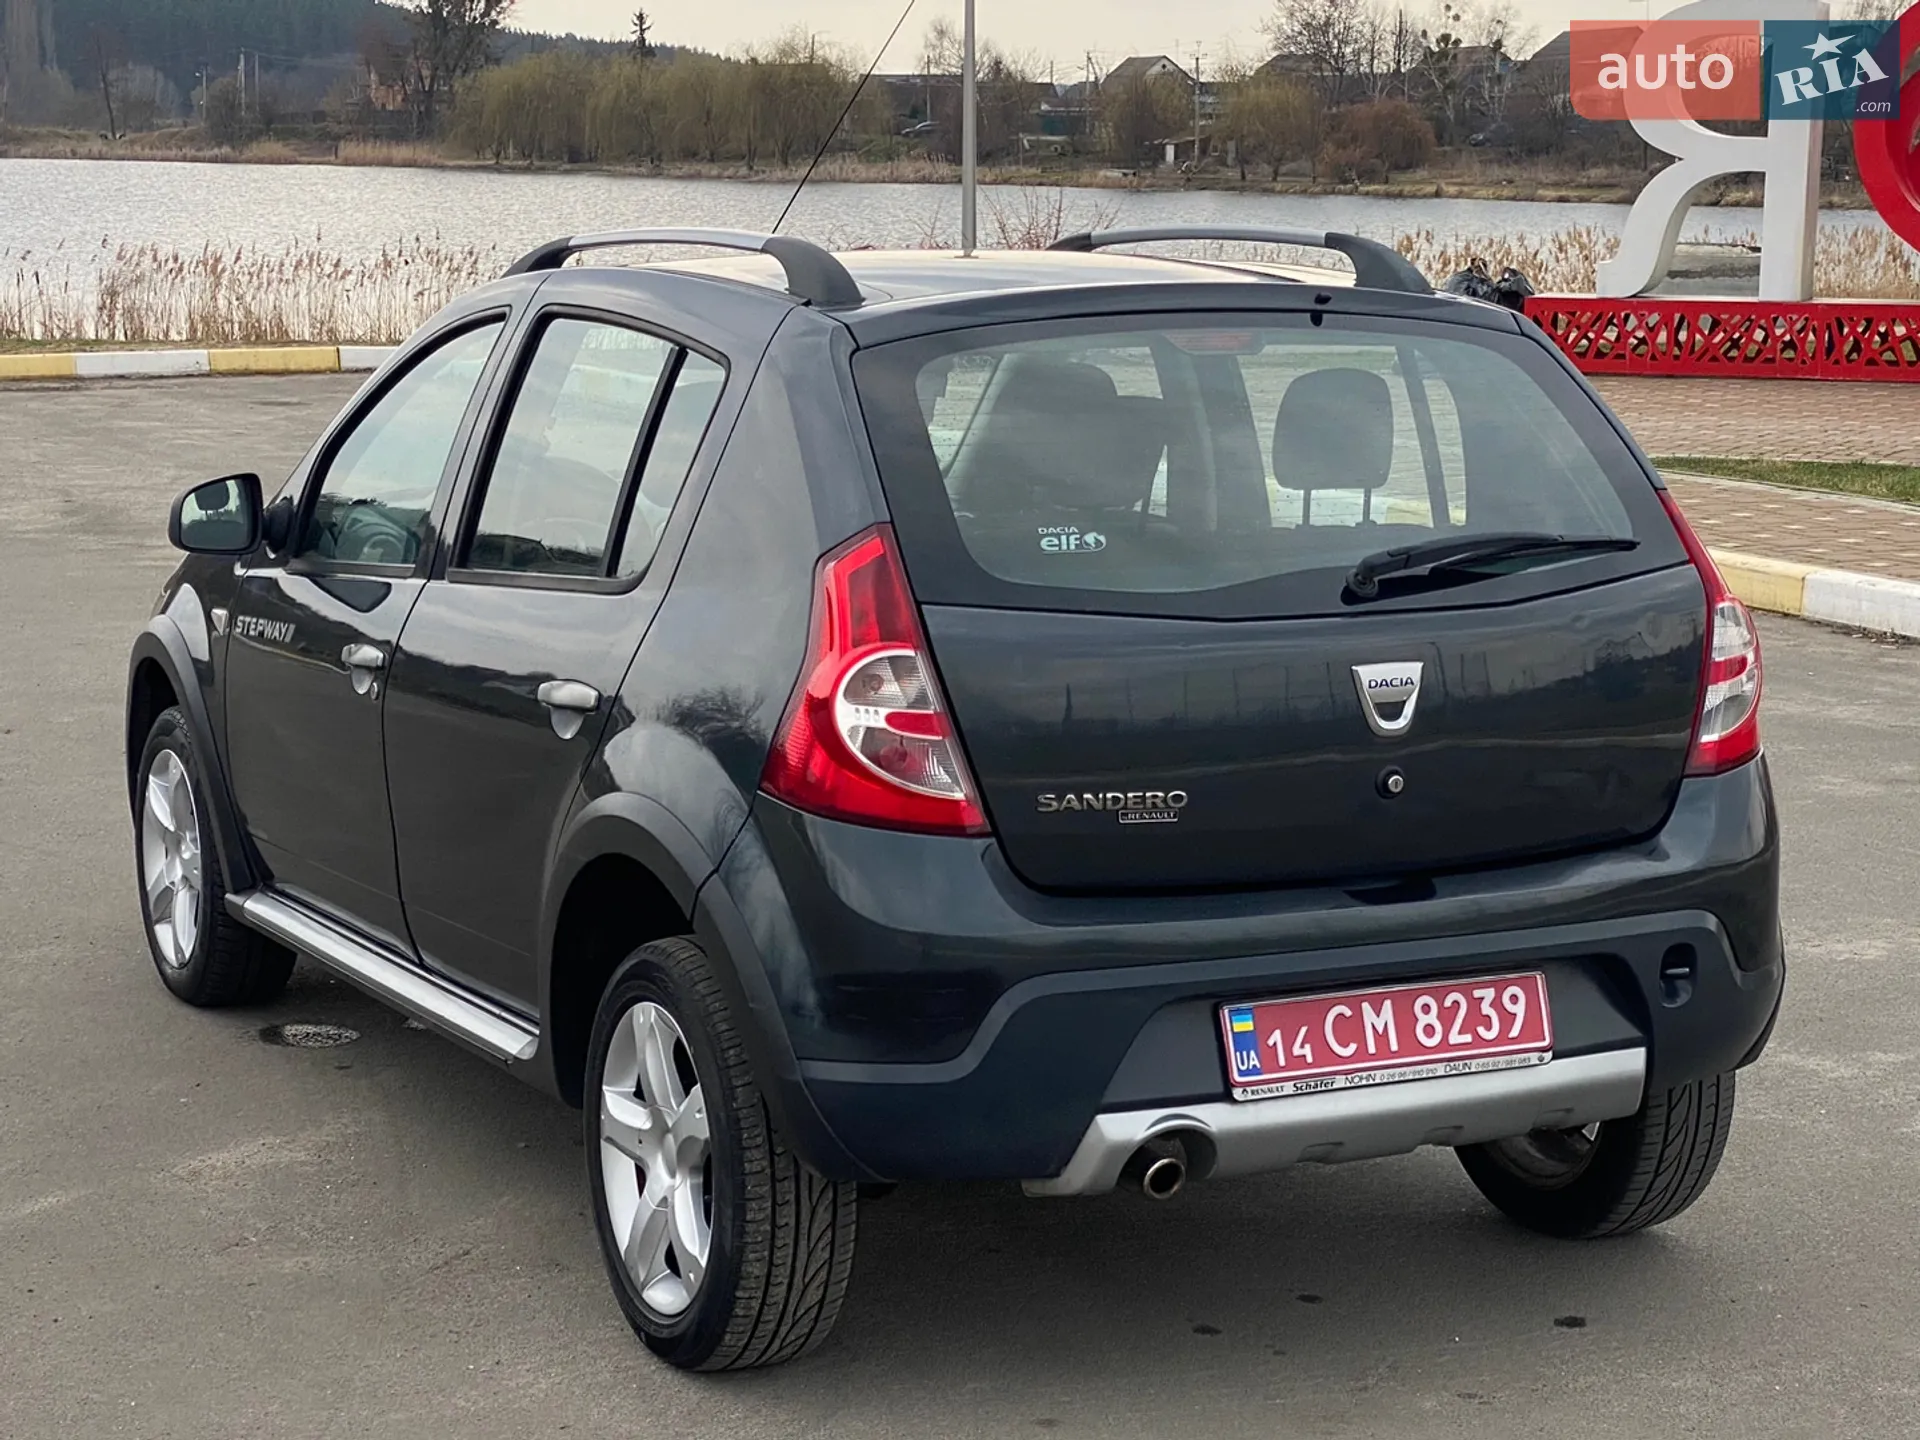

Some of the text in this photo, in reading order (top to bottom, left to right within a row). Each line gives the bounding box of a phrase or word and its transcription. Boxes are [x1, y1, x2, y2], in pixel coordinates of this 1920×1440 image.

[1038, 526, 1079, 535] DACIA
[1040, 534, 1080, 551] elf
[235, 615, 288, 641] STEPWAY
[1368, 677, 1415, 689] DACIA
[1037, 790, 1188, 812] SANDERO
[1128, 811, 1175, 820] RENAULT
[1266, 985, 1527, 1068] 14 CM 8239
[1236, 1050, 1261, 1071] UA
[1250, 1085, 1285, 1097] RENAULT
[1344, 1073, 1377, 1085] NOHN
